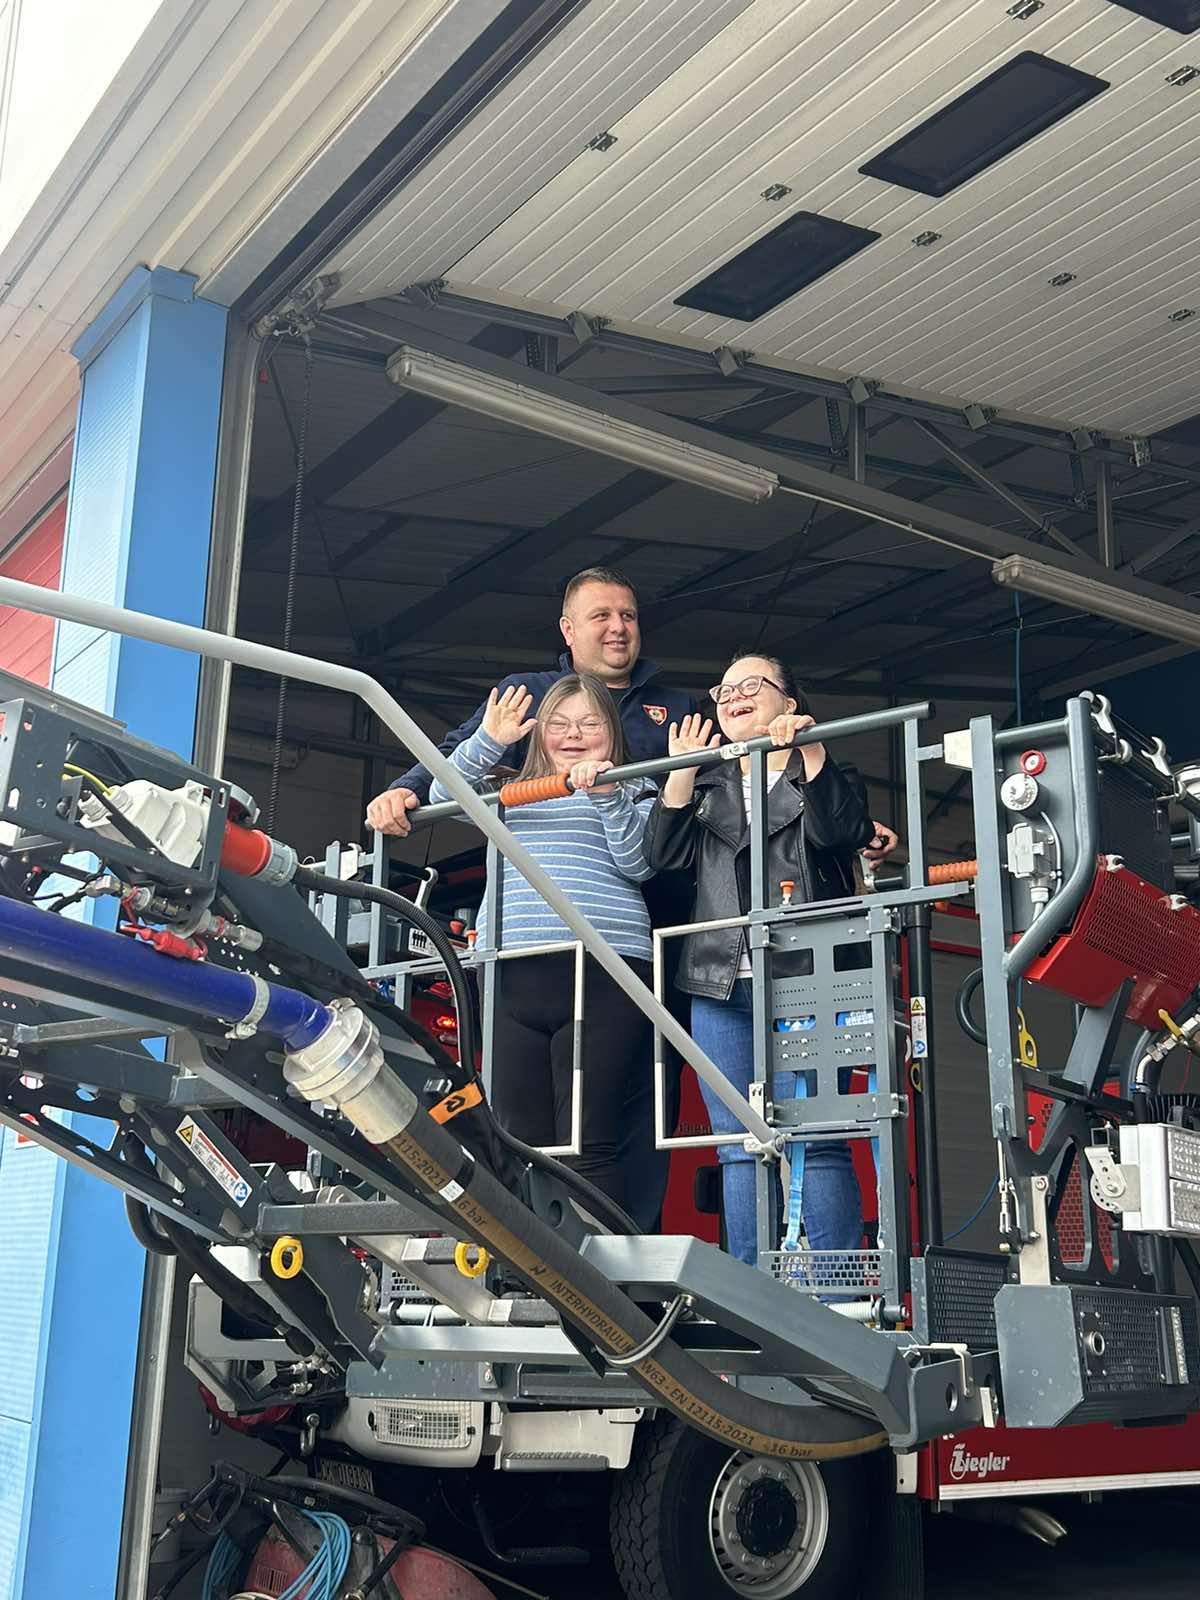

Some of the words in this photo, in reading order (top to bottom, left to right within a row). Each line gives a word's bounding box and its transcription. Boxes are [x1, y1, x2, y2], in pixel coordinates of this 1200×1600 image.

[466, 1206, 488, 1227] bar
[669, 1387, 690, 1406] EN
[790, 1445, 815, 1457] bar
[950, 1443, 1010, 1480] Ziegler
